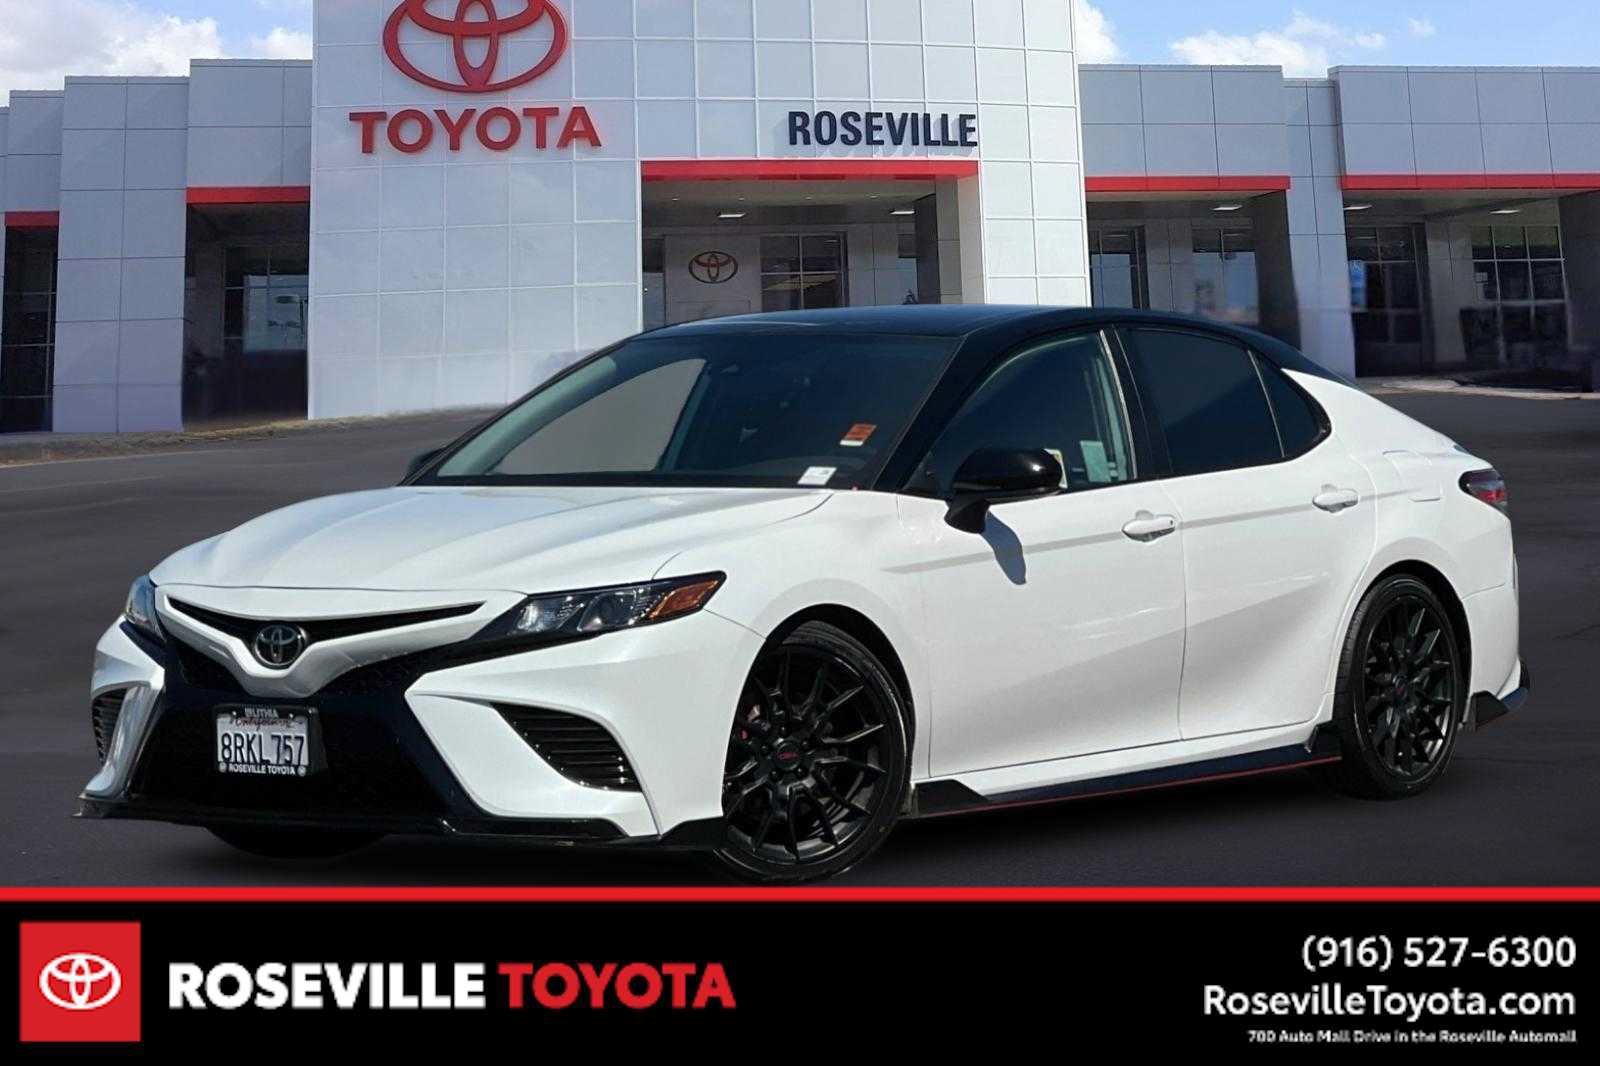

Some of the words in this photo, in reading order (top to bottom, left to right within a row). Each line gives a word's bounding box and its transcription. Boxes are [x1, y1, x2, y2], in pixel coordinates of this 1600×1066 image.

[350, 106, 603, 154] TOYOTA
[788, 111, 978, 147] ROSEVILLE
[228, 764, 266, 774] ROSEVILLE
[267, 765, 296, 775] TOYOTA
